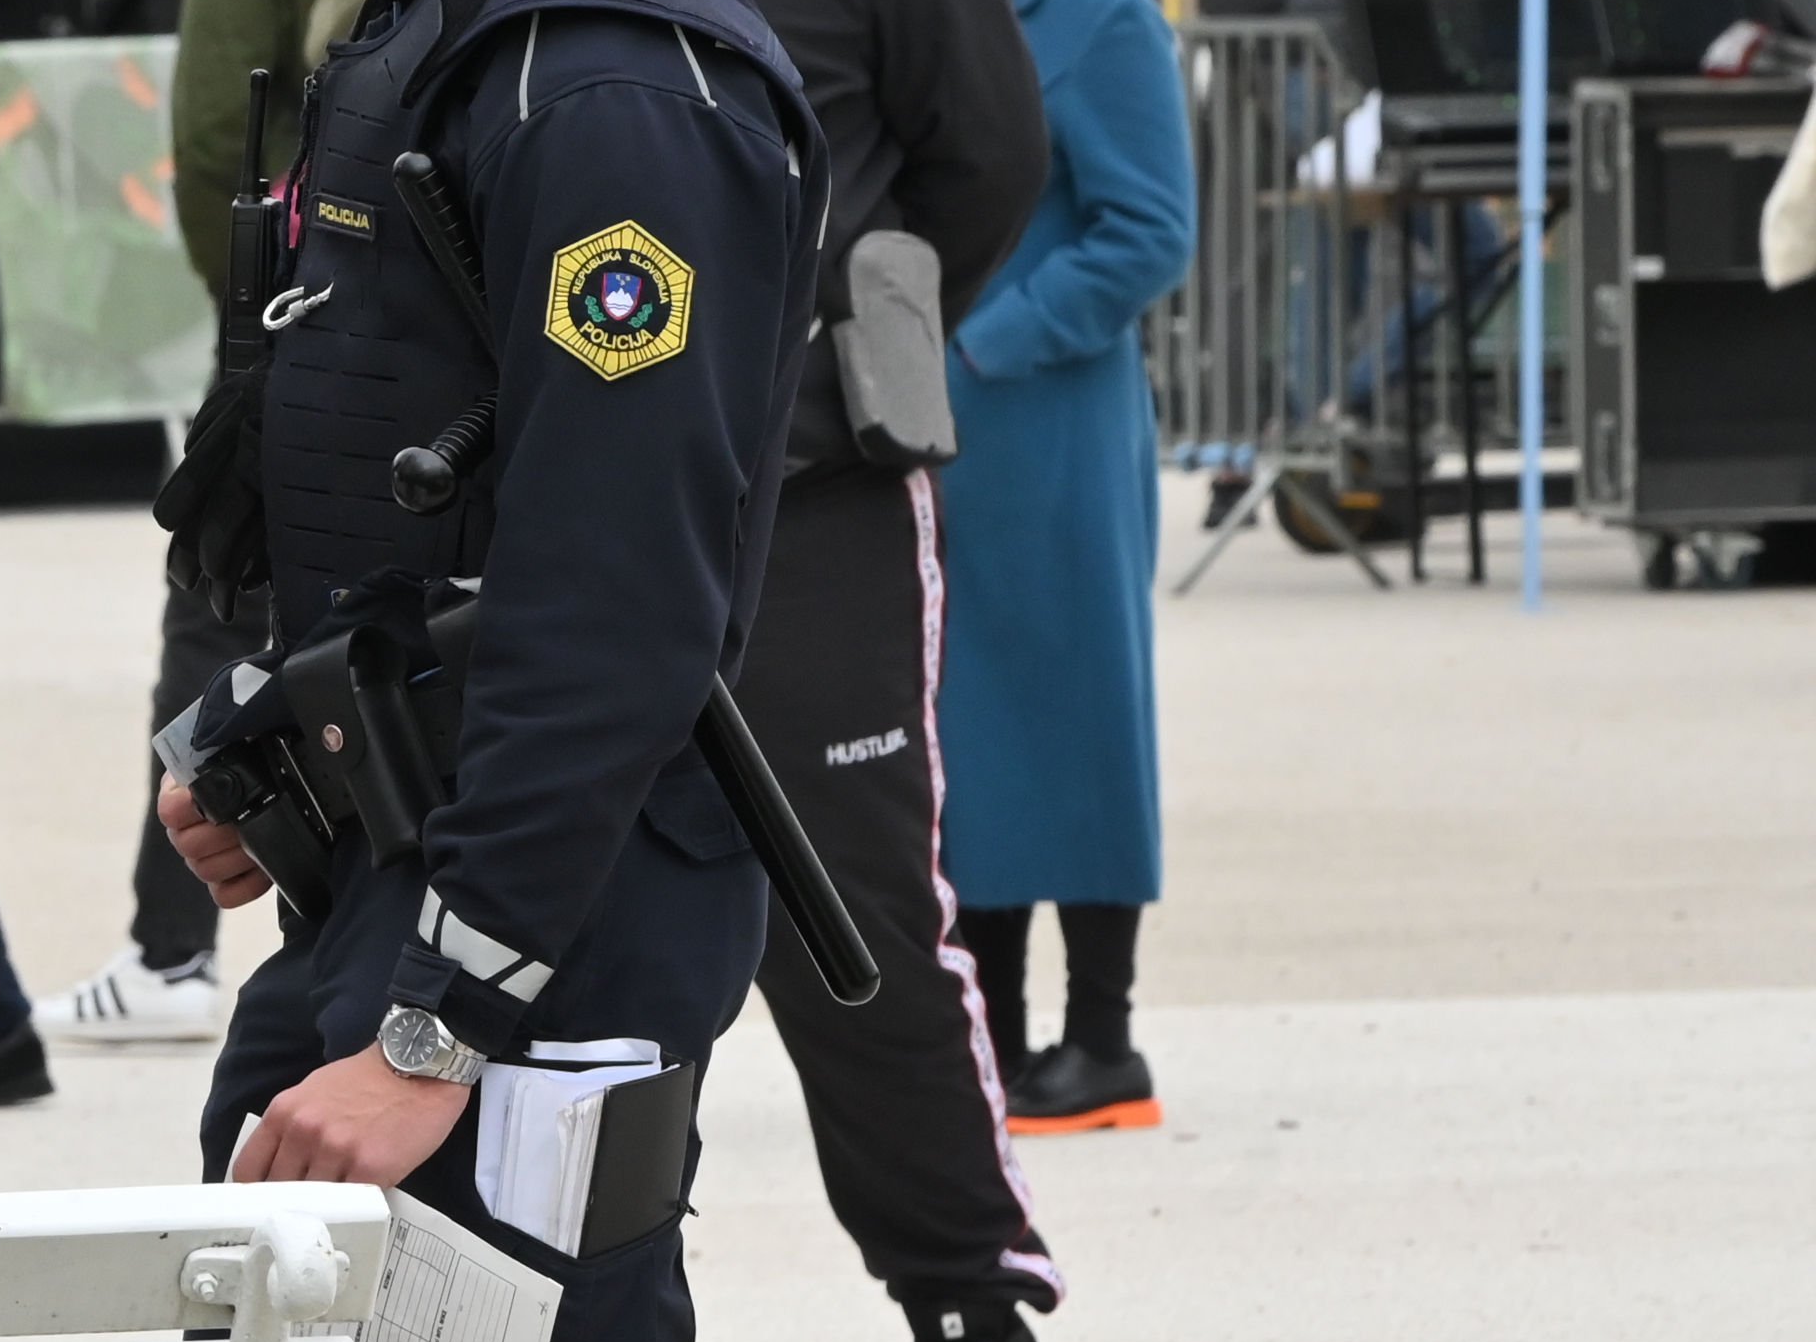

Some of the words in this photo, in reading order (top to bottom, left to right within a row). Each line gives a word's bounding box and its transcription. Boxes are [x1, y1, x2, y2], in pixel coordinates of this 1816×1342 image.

[318, 202, 370, 230] POLICIJA
[572, 250, 621, 295] REPUBLIKA
[629, 253, 670, 304] SLOVENIJA
[579, 320, 655, 350] POLICIJA
